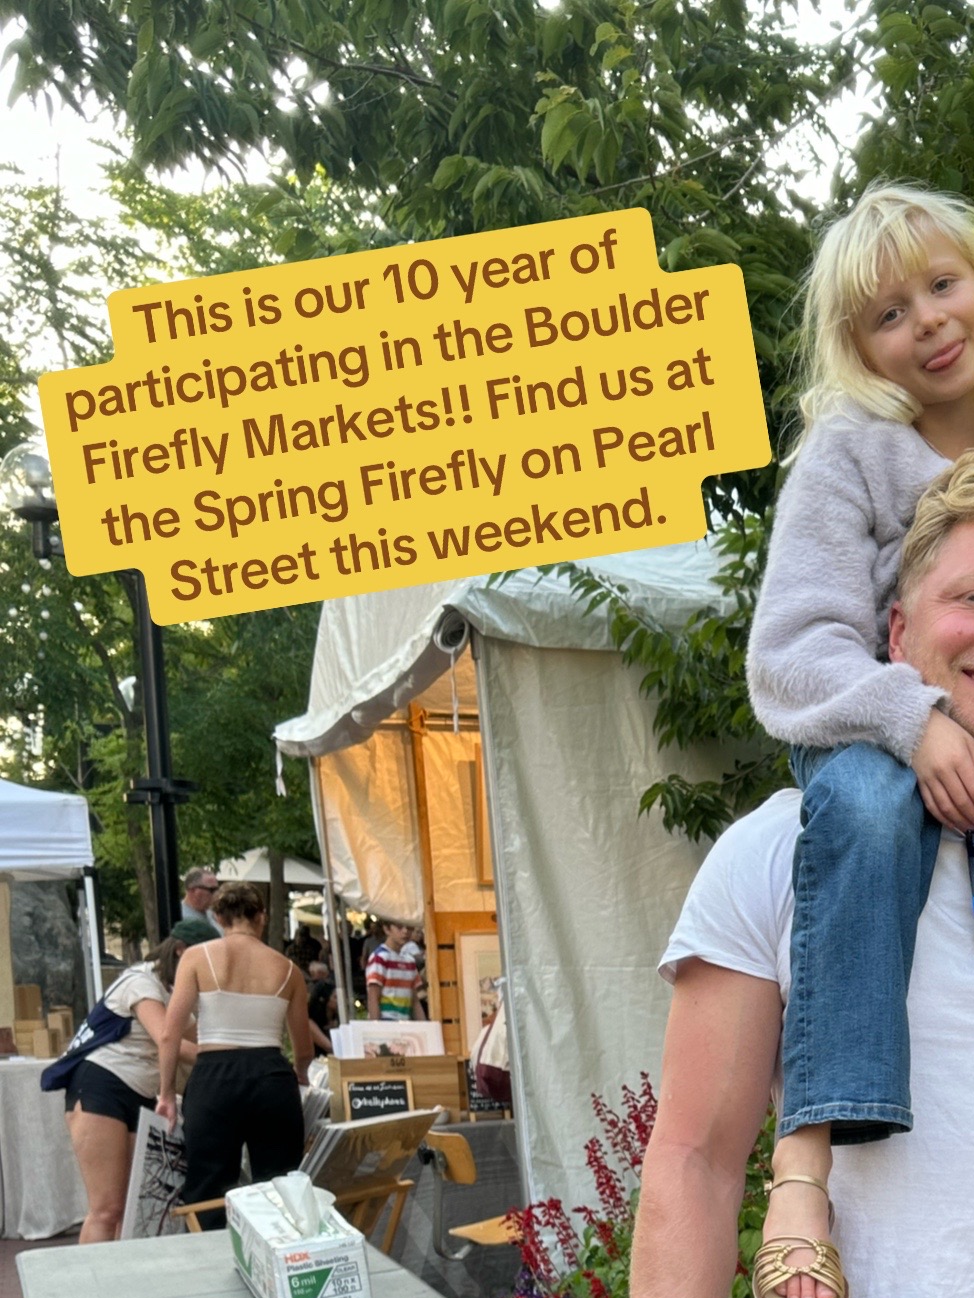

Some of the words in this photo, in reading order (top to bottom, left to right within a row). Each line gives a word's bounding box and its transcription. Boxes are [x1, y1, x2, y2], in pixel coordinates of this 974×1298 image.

[284, 1251, 310, 1264] HDX
[286, 1262, 313, 1273] Plastic
[315, 1256, 349, 1267] Sheeting
[291, 1276, 300, 1288] 6
[300, 1275, 317, 1287] mil
